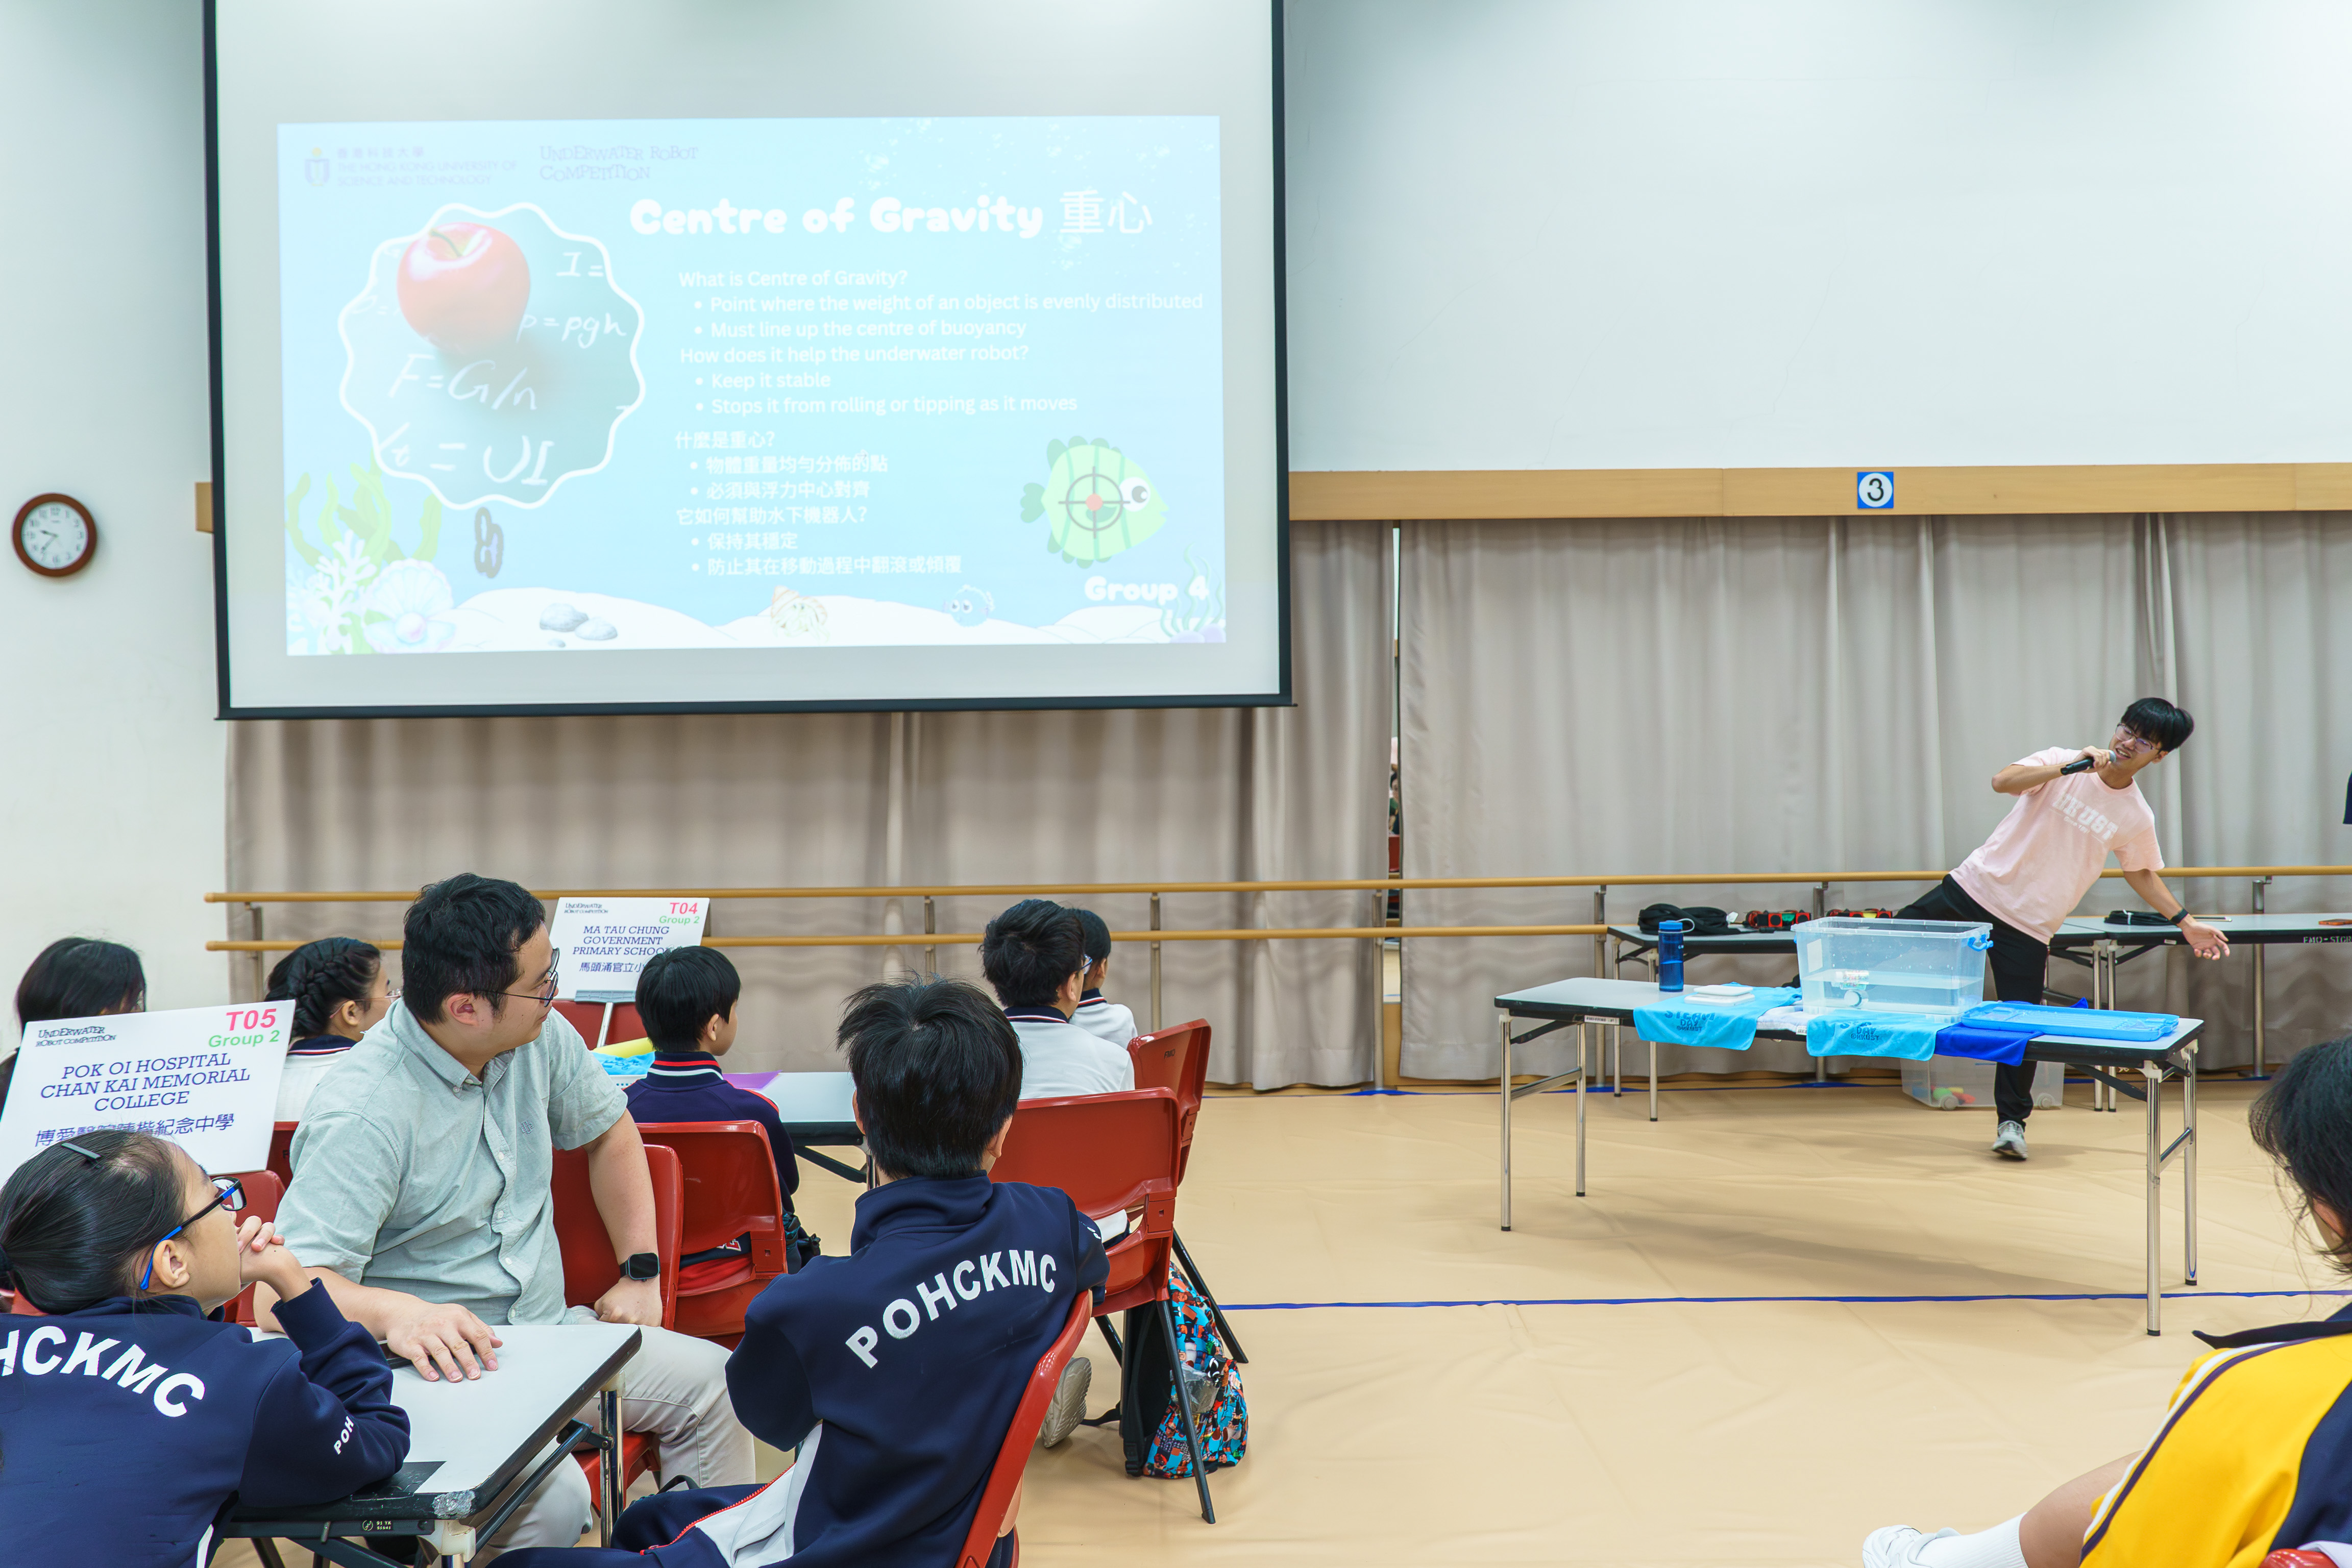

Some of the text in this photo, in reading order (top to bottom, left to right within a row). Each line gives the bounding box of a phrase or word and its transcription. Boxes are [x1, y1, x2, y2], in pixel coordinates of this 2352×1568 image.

[538, 145, 699, 161] UNDERWATER ROBOT
[338, 159, 517, 172] THE HONG KONG UNIVERSITY OF
[337, 175, 491, 186] SCIENCE AND TECHNOLOGY
[630, 189, 1153, 238] Centre of Gravity 重心
[679, 270, 908, 288] What is Centre of Gravity?
[711, 293, 1203, 314] Point where the weight of an object is evenly distributed
[712, 320, 1026, 340] Must line up the centre of buoyancy
[681, 345, 1029, 365] How does it help the underwater robot?
[713, 372, 831, 391] Keep it stable
[712, 396, 1077, 416] Stops it from rolling or tipping as it moves
[675, 431, 775, 449] 什麼是重心?
[706, 452, 888, 474] 物體重量均勻分佈的點
[706, 480, 870, 499] 必須與浮力中心對齊
[1867, 478, 1884, 502] 3
[676, 506, 867, 525] 它如何幫助水下機器人?
[707, 531, 798, 550] 保持其穩定
[1085, 576, 1209, 605] Group 4
[670, 902, 698, 915] T04
[583, 925, 670, 935] MA TAU CHUNG
[659, 916, 690, 925] Group
[583, 936, 663, 945] GOVERNMENT
[572, 947, 668, 955] PRIMARY SCHOO
[226, 1008, 277, 1031] T05
[38, 1026, 105, 1038] UNDERWATER
[63, 1034, 117, 1044] COMPETITION
[208, 1030, 280, 1047] Group 2
[1856, 1026, 1876, 1035] DAY
[61, 1052, 231, 1080] POK OI HOSPITAL
[40, 1068, 251, 1099] CHAN KAI MEMORIAL
[94, 1090, 190, 1112] COLLEGE
[845, 1250, 1056, 1368] POHCKMC
[333, 1415, 354, 1455] POH
